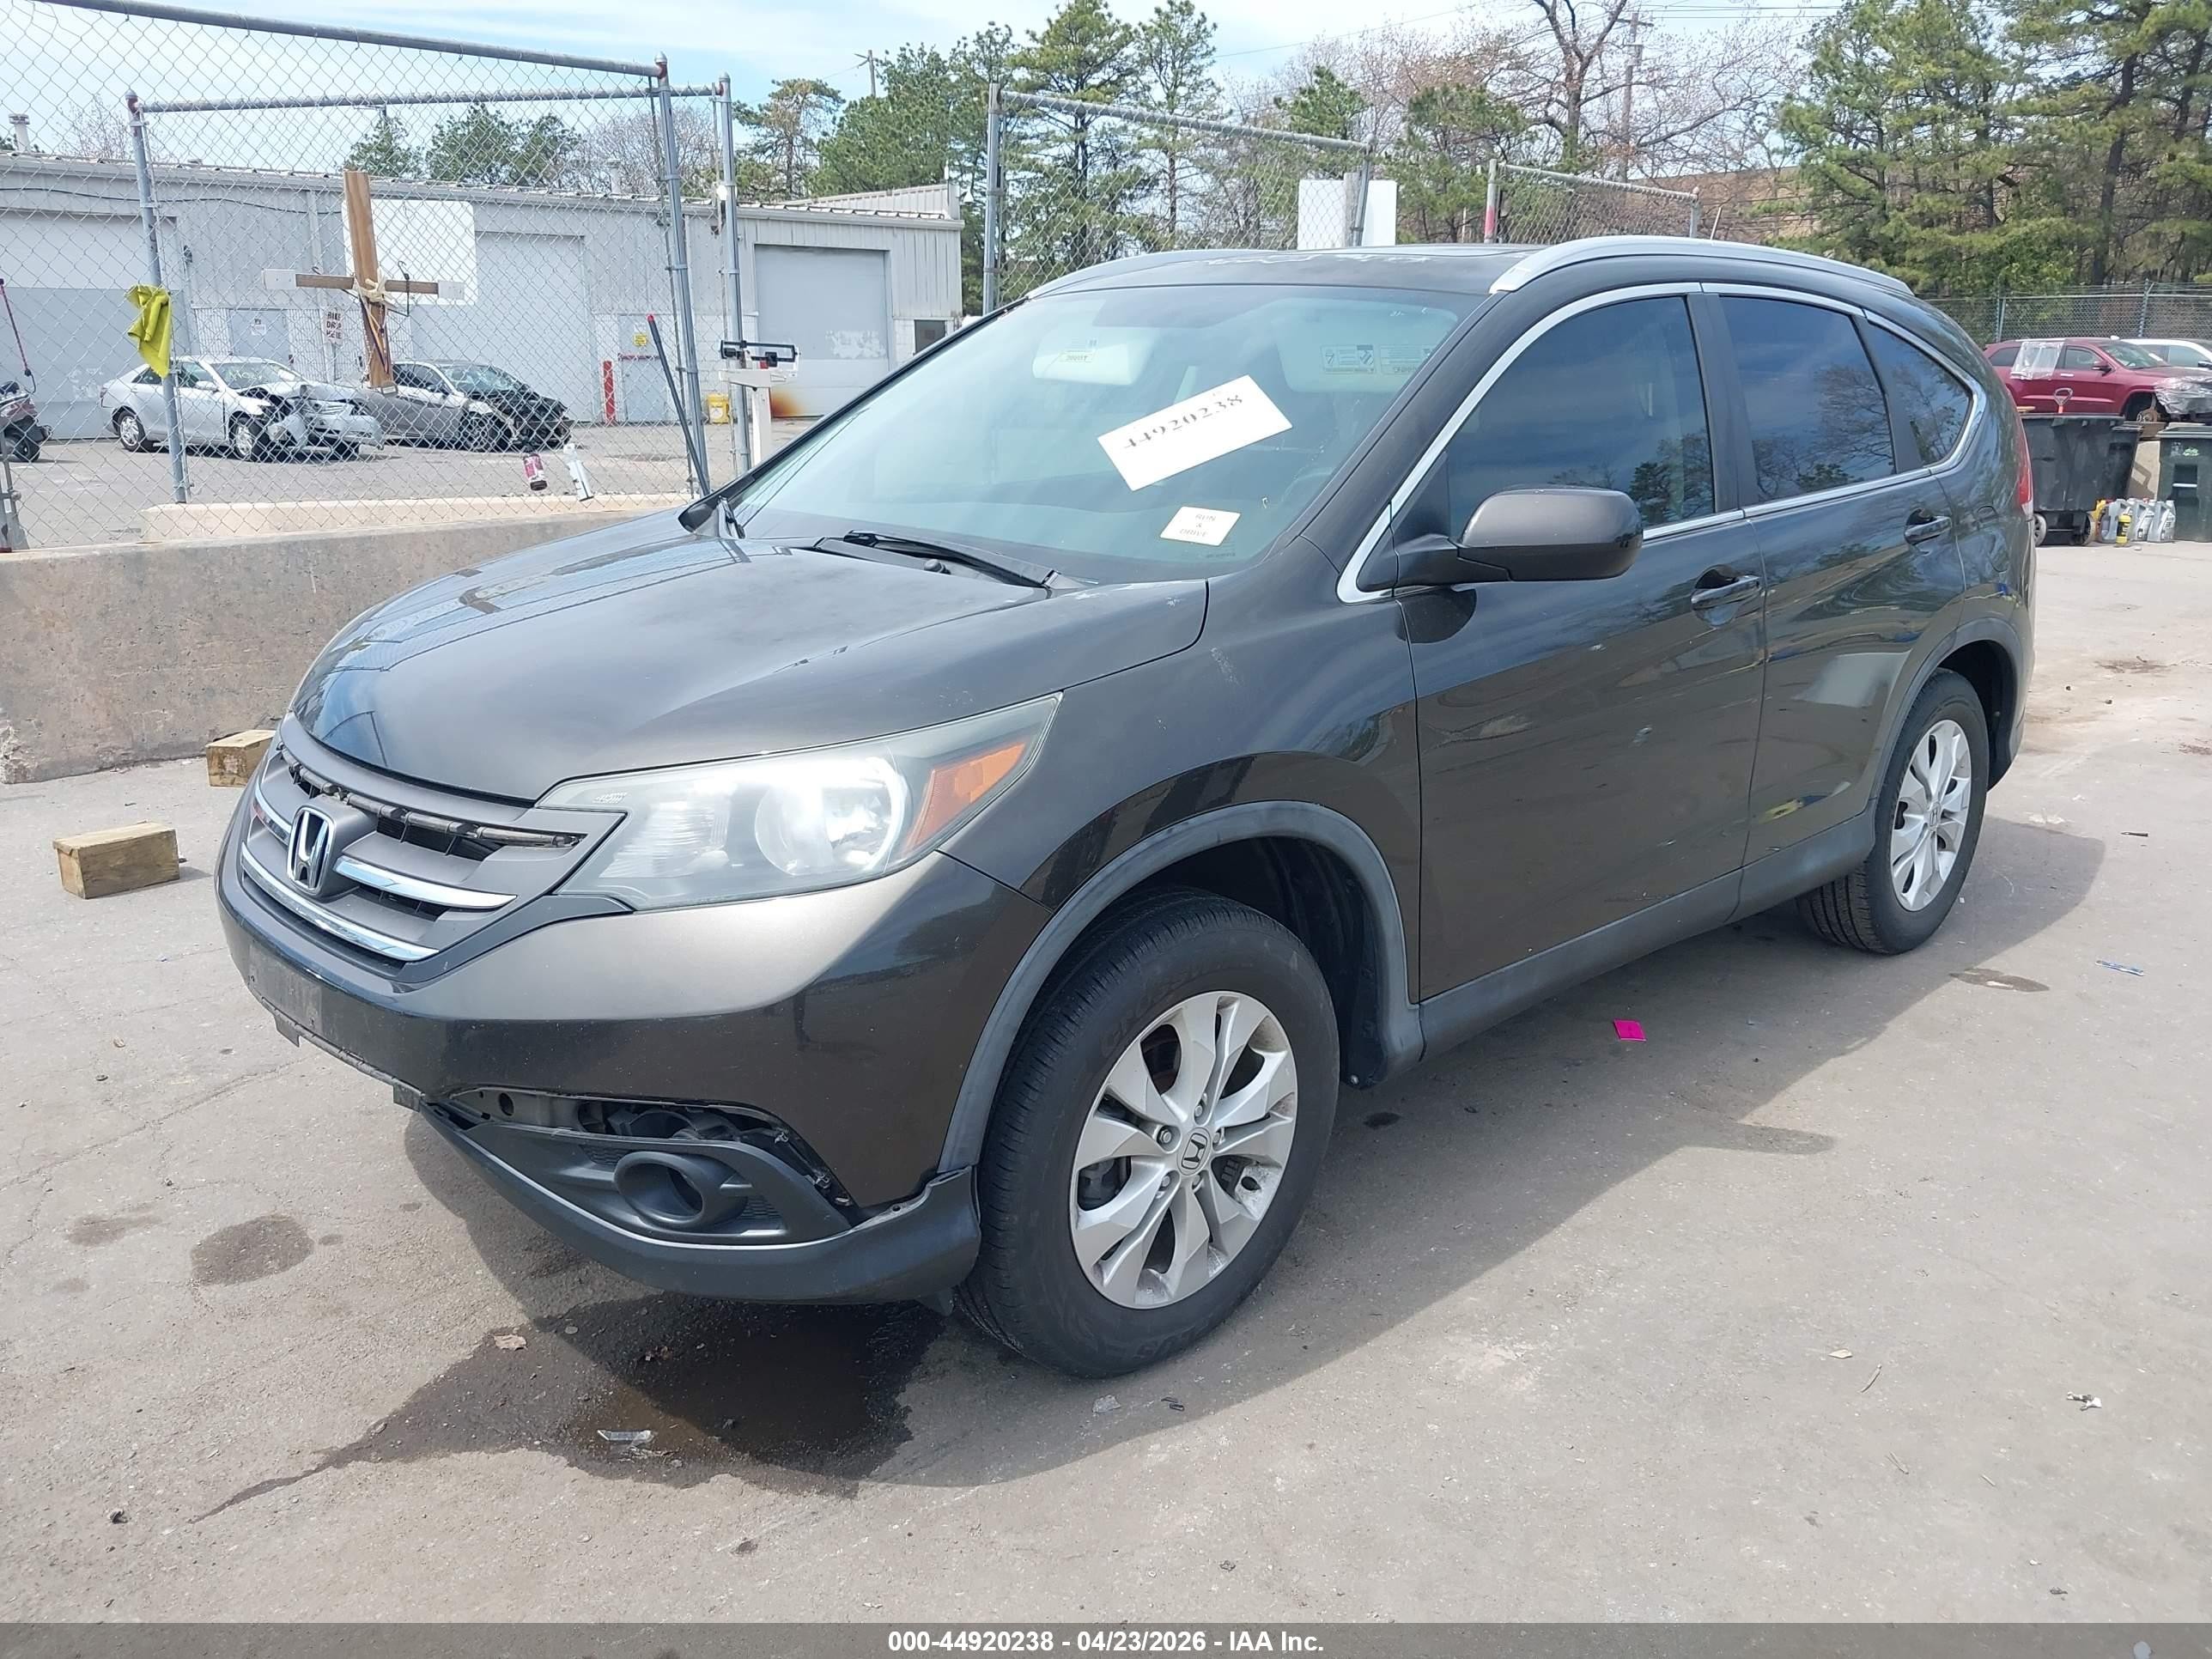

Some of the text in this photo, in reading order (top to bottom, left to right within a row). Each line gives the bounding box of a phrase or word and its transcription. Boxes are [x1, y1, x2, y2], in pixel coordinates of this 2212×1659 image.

[1123, 394, 1243, 449] 44920238
[1194, 514, 1217, 522] RUN
[1179, 528, 1208, 538] DRIVE
